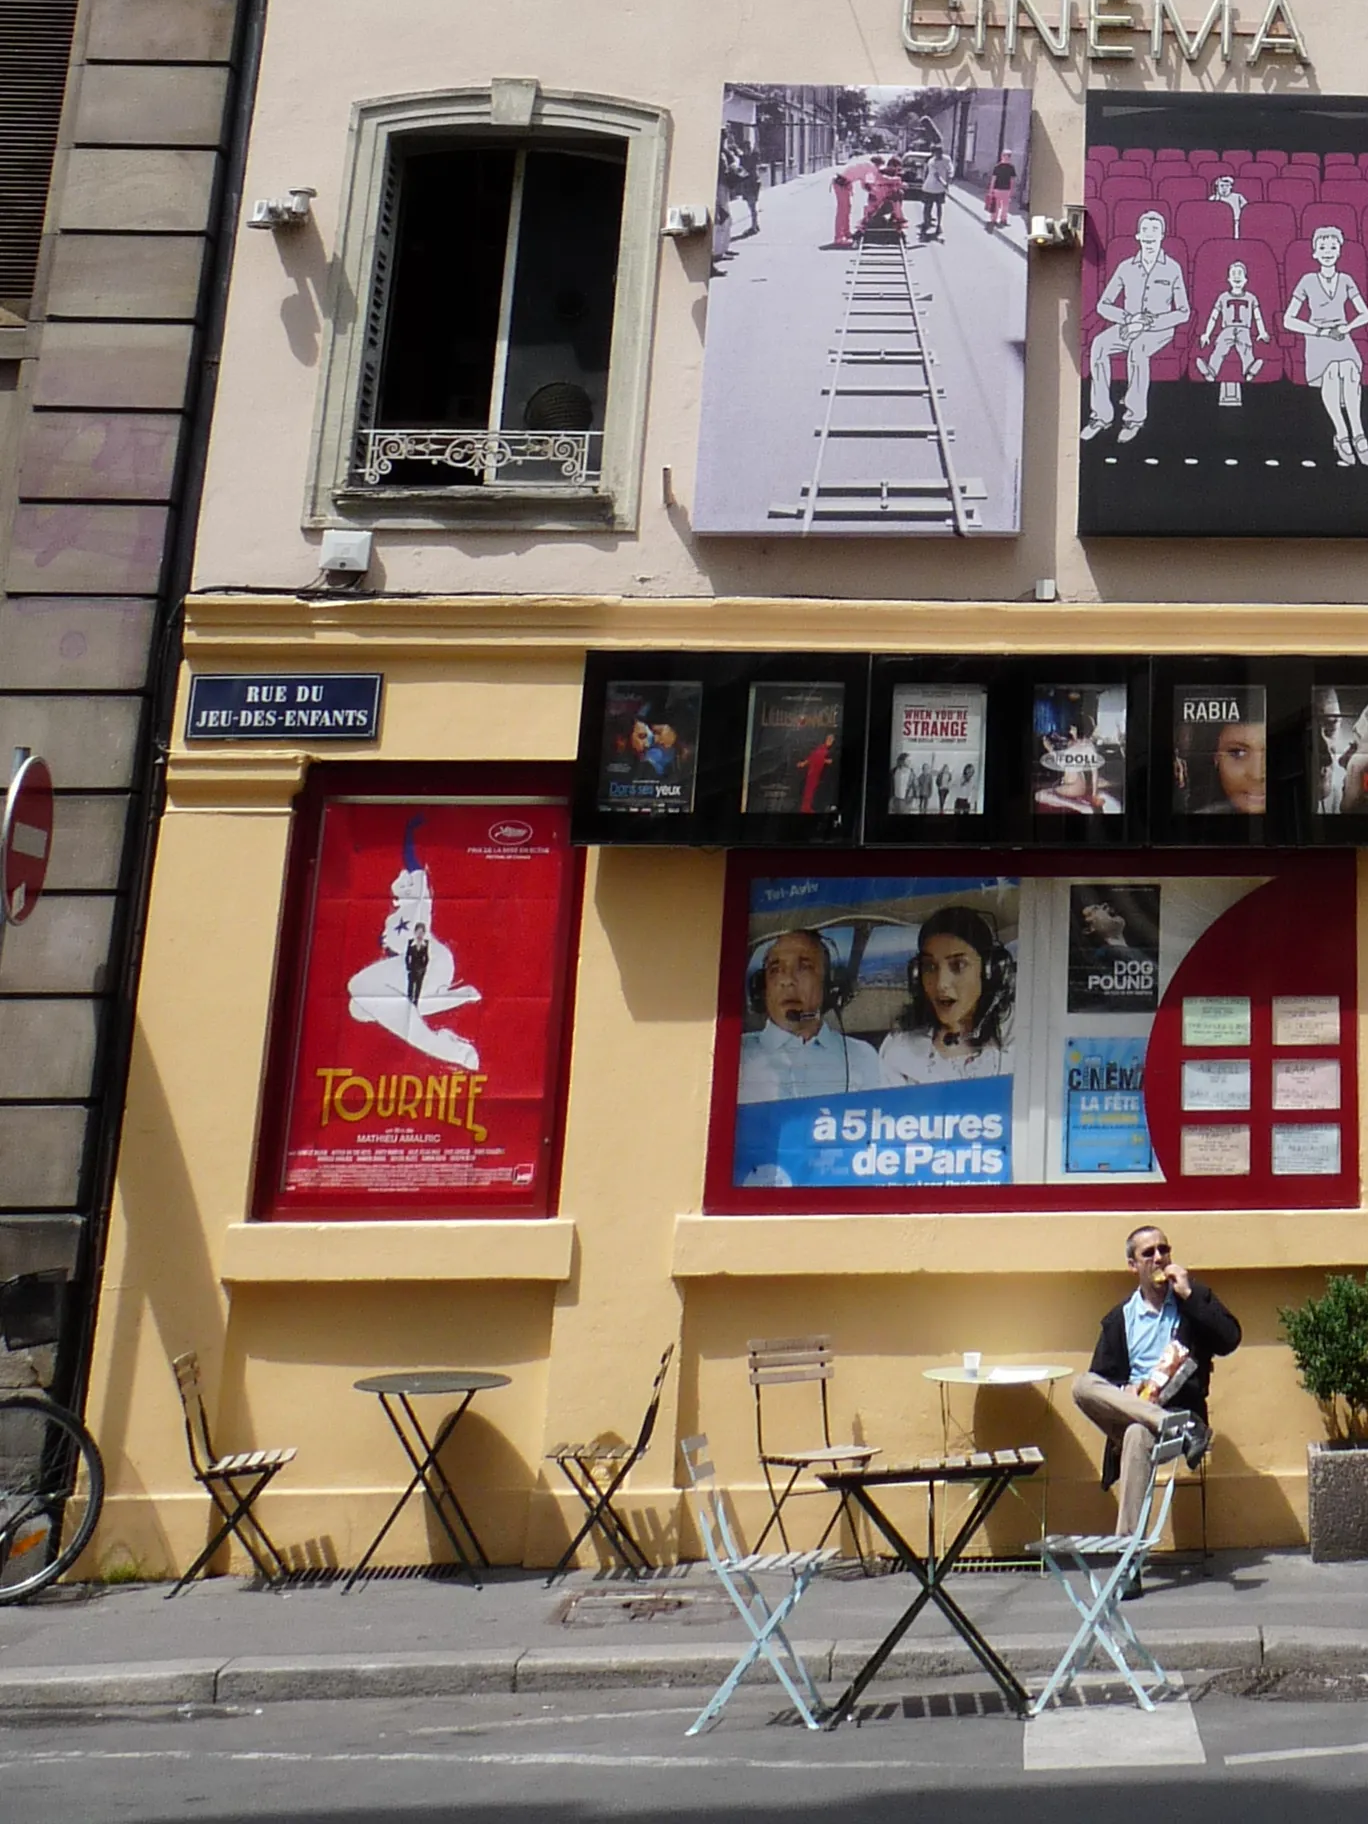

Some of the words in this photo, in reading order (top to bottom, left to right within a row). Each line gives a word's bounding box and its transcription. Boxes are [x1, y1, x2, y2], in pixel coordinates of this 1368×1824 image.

[1227, 299, 1249, 323] T
[246, 686, 287, 703] RUE
[296, 686, 324, 702] DU
[196, 709, 368, 727] JEU-DES-ENFANTS
[904, 709, 932, 720] WHEN
[935, 709, 968, 720] YOU'RE
[1183, 702, 1241, 720] RABIA
[902, 721, 968, 737] STRANGE
[655, 785, 681, 798] yeux
[1114, 961, 1153, 975] DOG
[1088, 976, 1153, 990] POUND
[316, 1067, 488, 1142] TOURNÉE
[1080, 1095, 1099, 1111] LA
[1104, 1093, 1140, 1111] FÊTE
[813, 1107, 837, 1141] à
[841, 1109, 867, 1141] 5
[871, 1107, 1003, 1141] heures
[356, 1134, 398, 1144] MATHIEU
[398, 1134, 441, 1144] AMALRIC
[852, 1143, 901, 1176] de
[904, 1143, 1003, 1176] Paris
